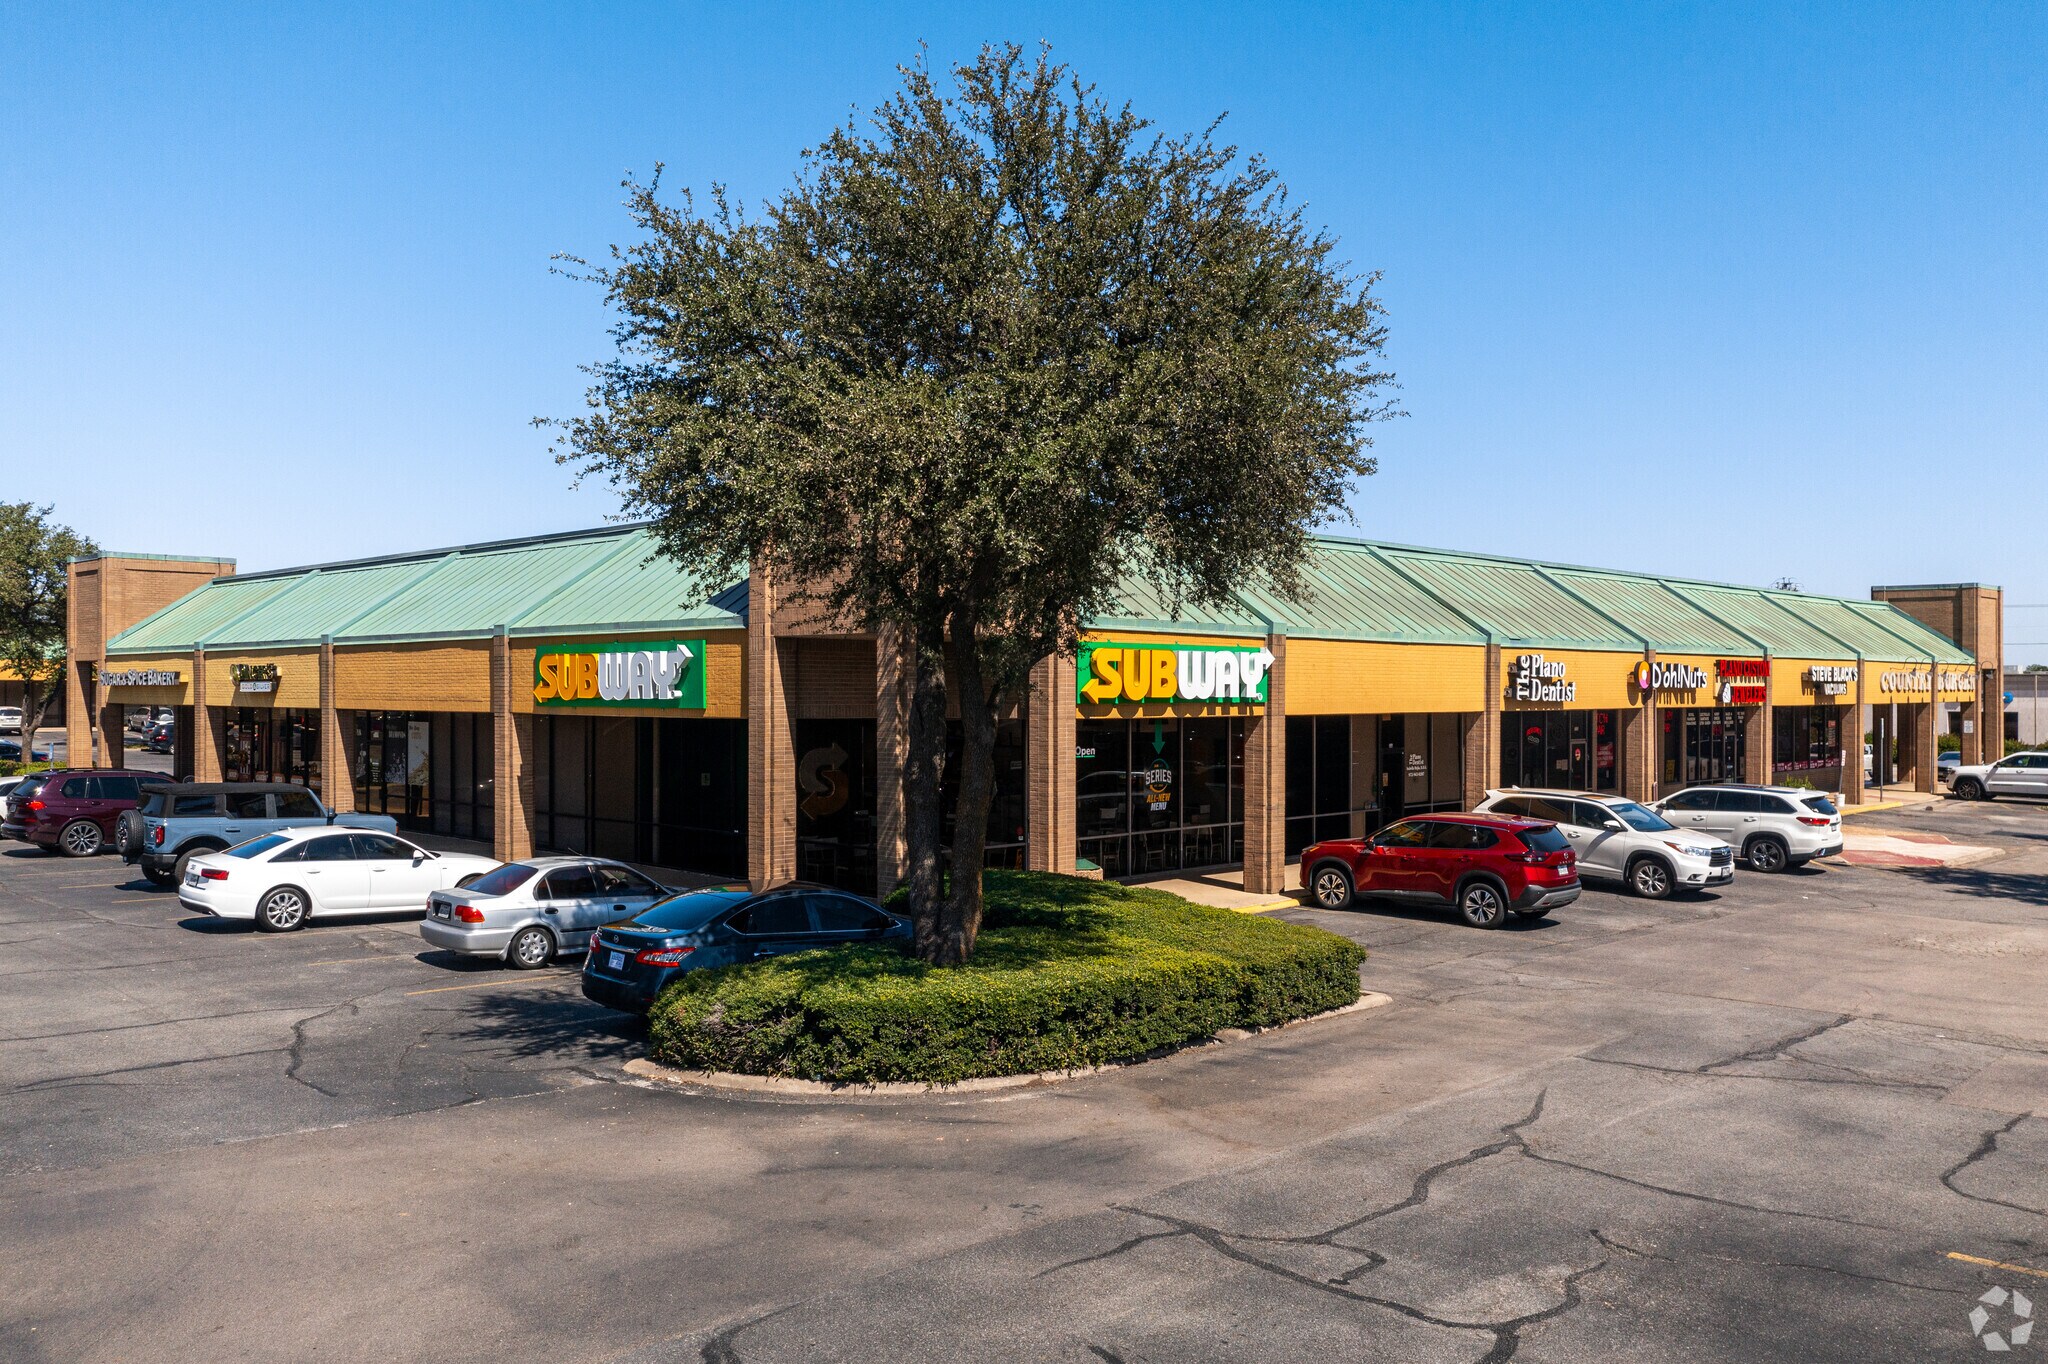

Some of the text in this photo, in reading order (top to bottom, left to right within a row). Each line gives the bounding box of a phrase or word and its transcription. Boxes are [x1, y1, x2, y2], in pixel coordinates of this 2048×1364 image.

[533, 644, 693, 703] SUBWAY
[1531, 654, 1566, 678] Plano
[1811, 665, 1832, 682] STEVE
[100, 669, 120, 686] SUGAR
[127, 669, 147, 686] SPICE
[147, 669, 176, 686] BAKERY
[1081, 647, 1276, 704] SUBWAY
[1516, 655, 1530, 700] The
[1530, 679, 1576, 702] Dentist
[1824, 682, 1848, 695] VACUUMS
[1076, 745, 1096, 758] Open
[1145, 769, 1172, 786] SERIES
[1146, 792, 1171, 804] ALL-NEW
[1150, 801, 1168, 811] MENU
